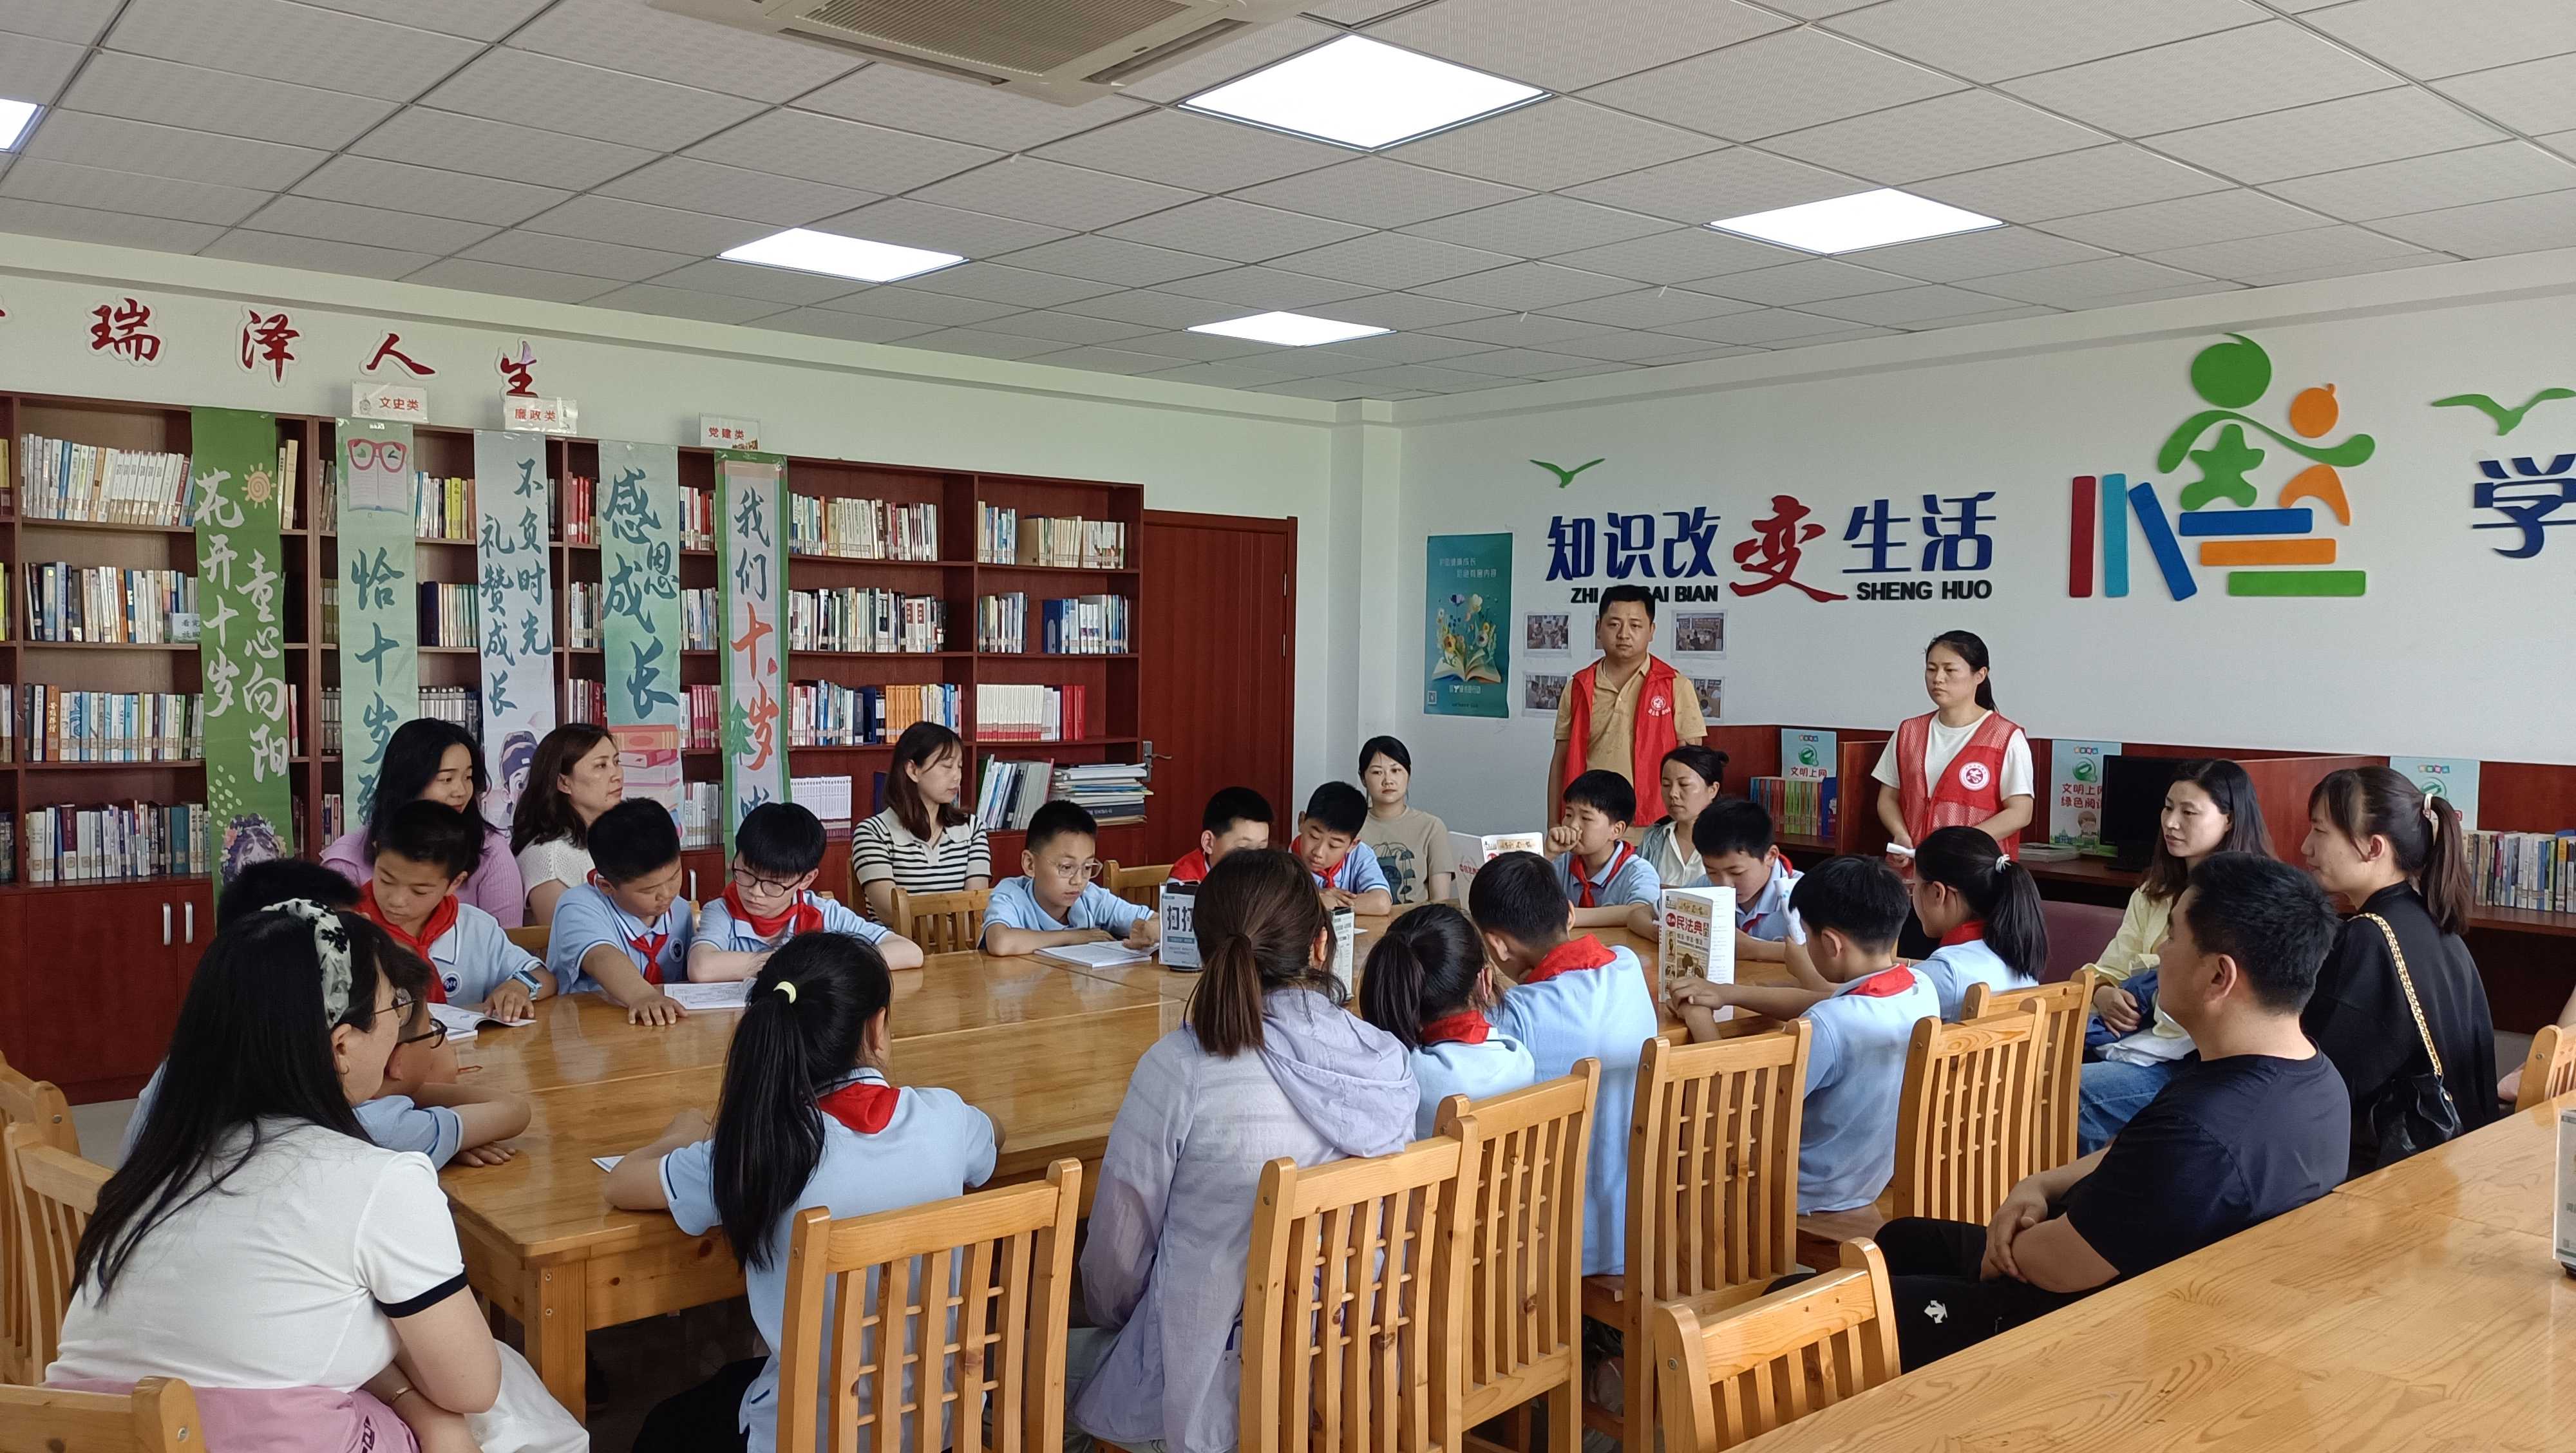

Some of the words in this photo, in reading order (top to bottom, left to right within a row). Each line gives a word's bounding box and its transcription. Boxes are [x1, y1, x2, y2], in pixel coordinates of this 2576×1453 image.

[0, 297, 539, 397] 瑞泽人生
[379, 396, 419, 411] 文史类
[515, 408, 556, 422] 廉政类
[709, 427, 744, 441] 党建类
[514, 458, 551, 656] 不负时光
[194, 466, 245, 717] 花开十岁
[1571, 587, 1598, 603] ZHI
[1648, 586, 1669, 603] AI
[1675, 585, 1718, 603] BIAN
[1857, 581, 1933, 600] SHENG
[1942, 580, 1993, 600] HUO
[478, 513, 518, 716] 礼赞成长
[236, 547, 289, 783] 童心向阳
[1790, 766, 1827, 777] 文明上网
[1676, 915, 1703, 936] 民法典
